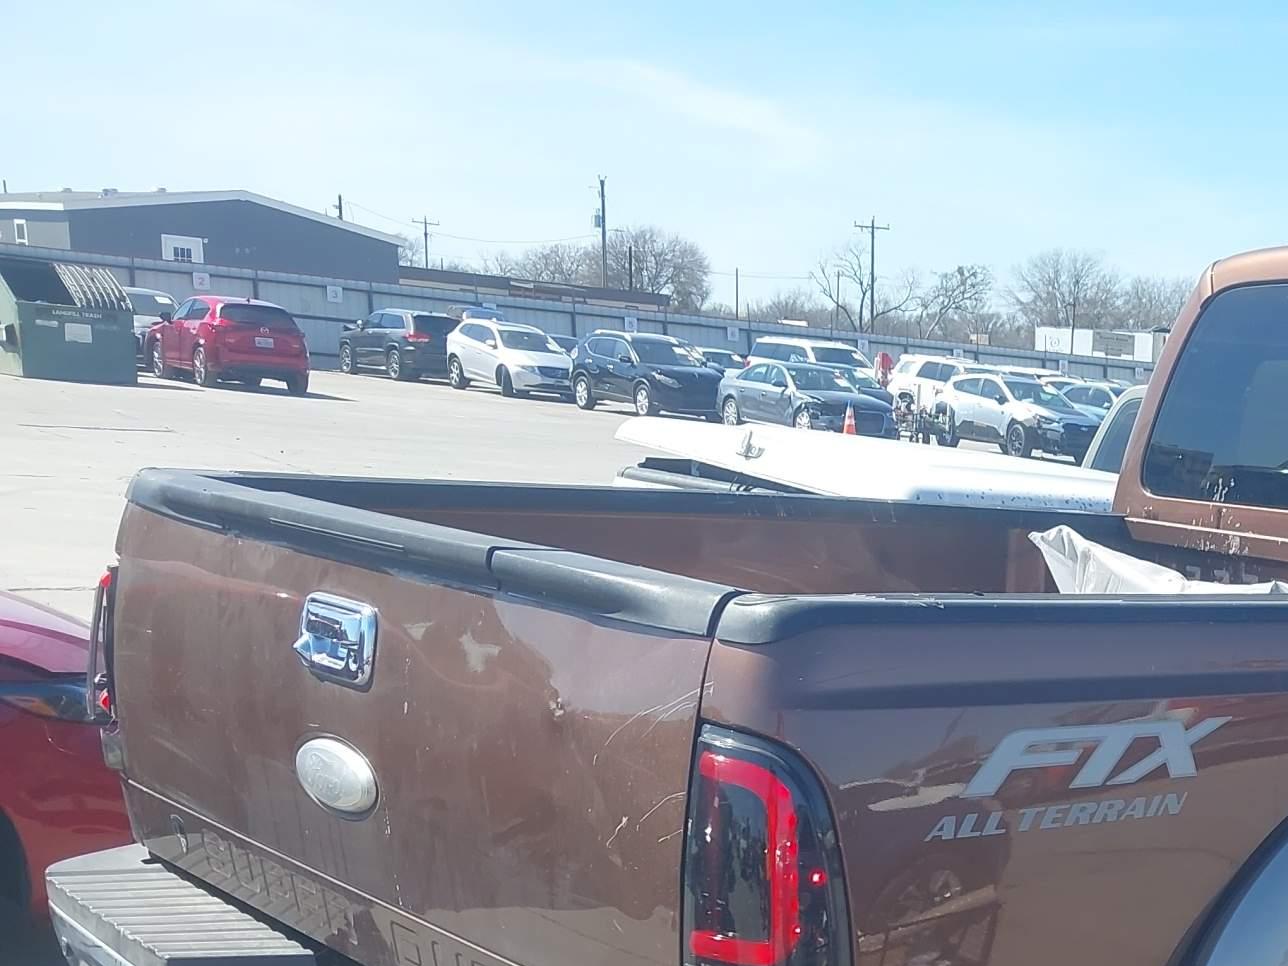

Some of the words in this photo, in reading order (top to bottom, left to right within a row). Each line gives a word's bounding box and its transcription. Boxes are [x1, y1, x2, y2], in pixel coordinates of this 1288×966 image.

[331, 290, 338, 299] 3
[960, 715, 1233, 798] FTX
[923, 812, 1007, 842] ALL
[1017, 791, 1188, 832] TERRAIN
